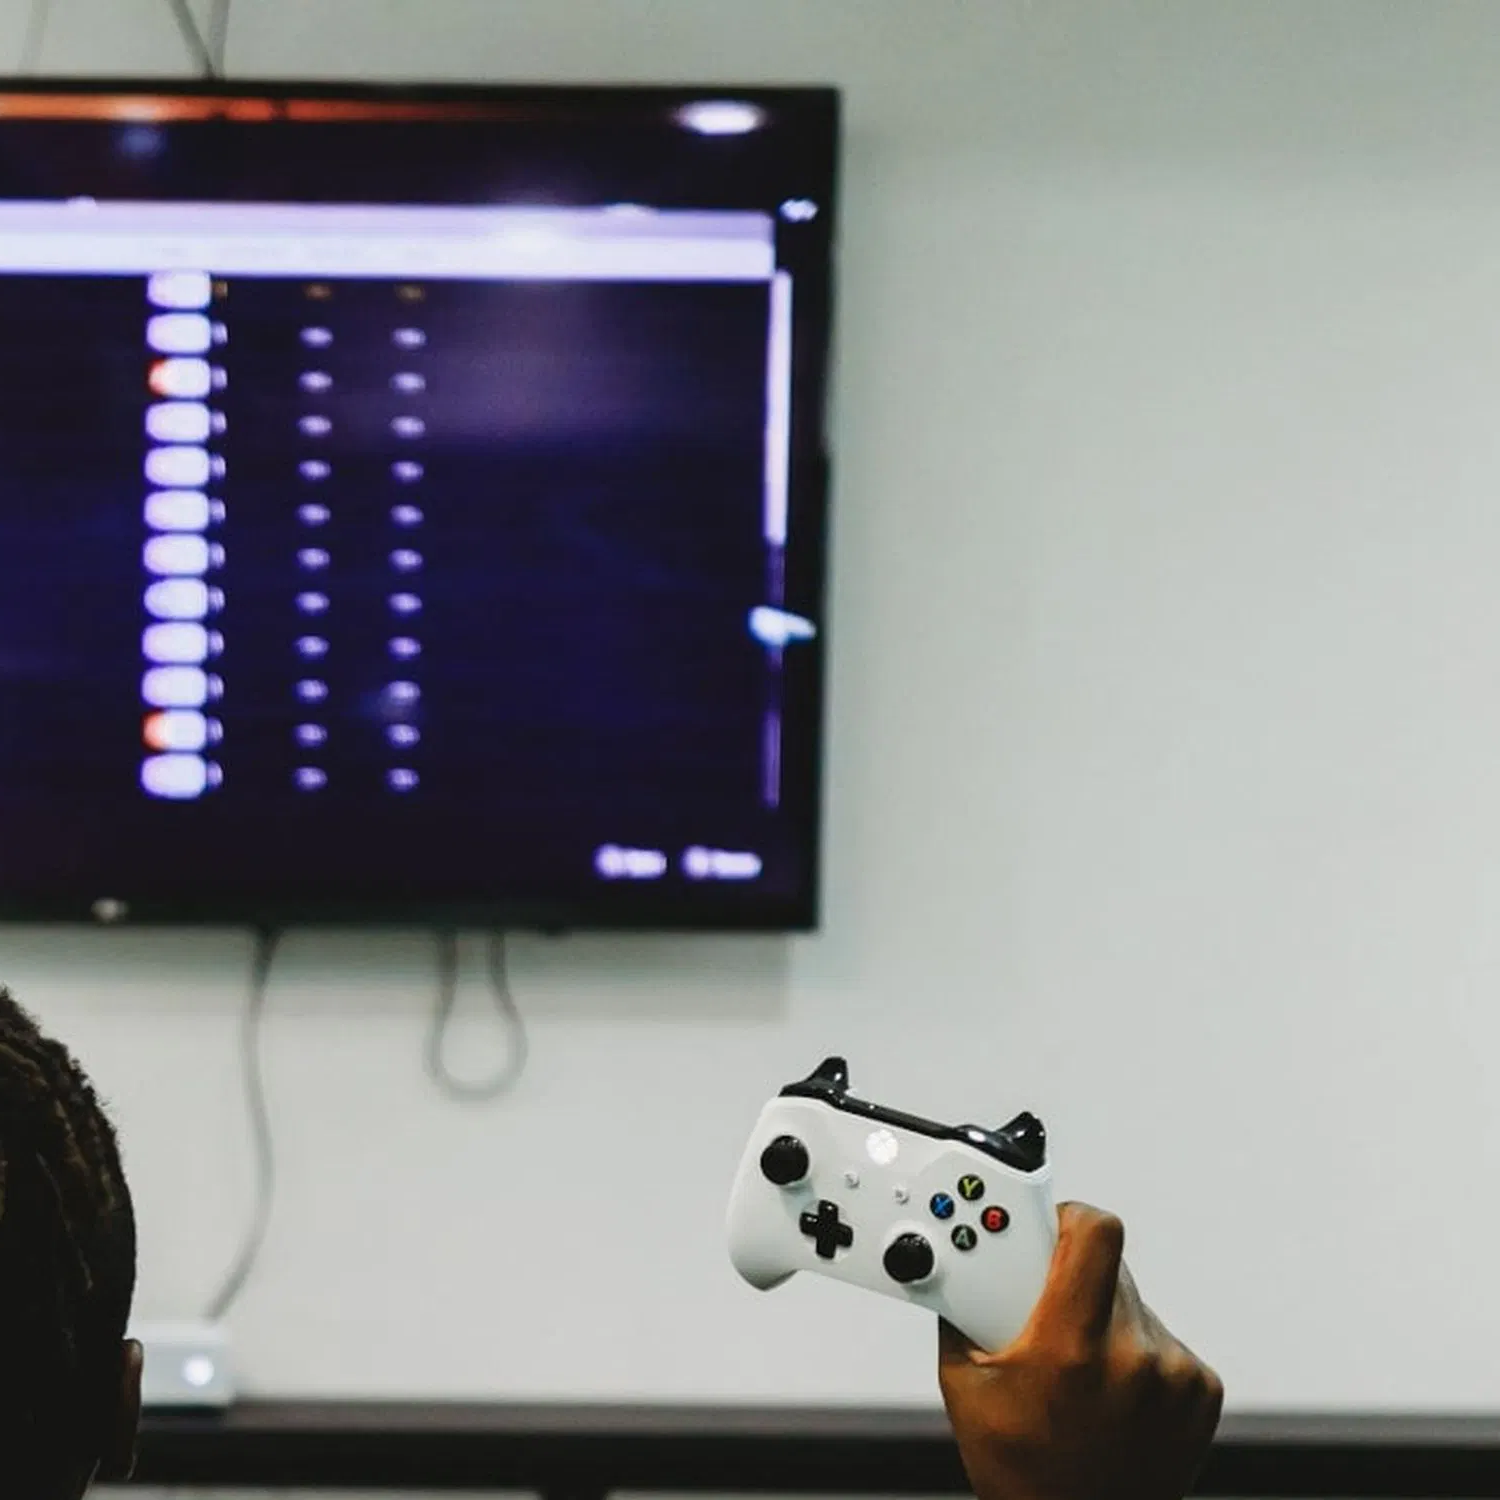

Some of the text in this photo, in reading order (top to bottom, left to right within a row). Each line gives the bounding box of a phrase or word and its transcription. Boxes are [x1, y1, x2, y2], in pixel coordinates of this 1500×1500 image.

[963, 1178, 979, 1198] Y
[935, 1196, 950, 1216] X
[955, 1227, 970, 1247] A
